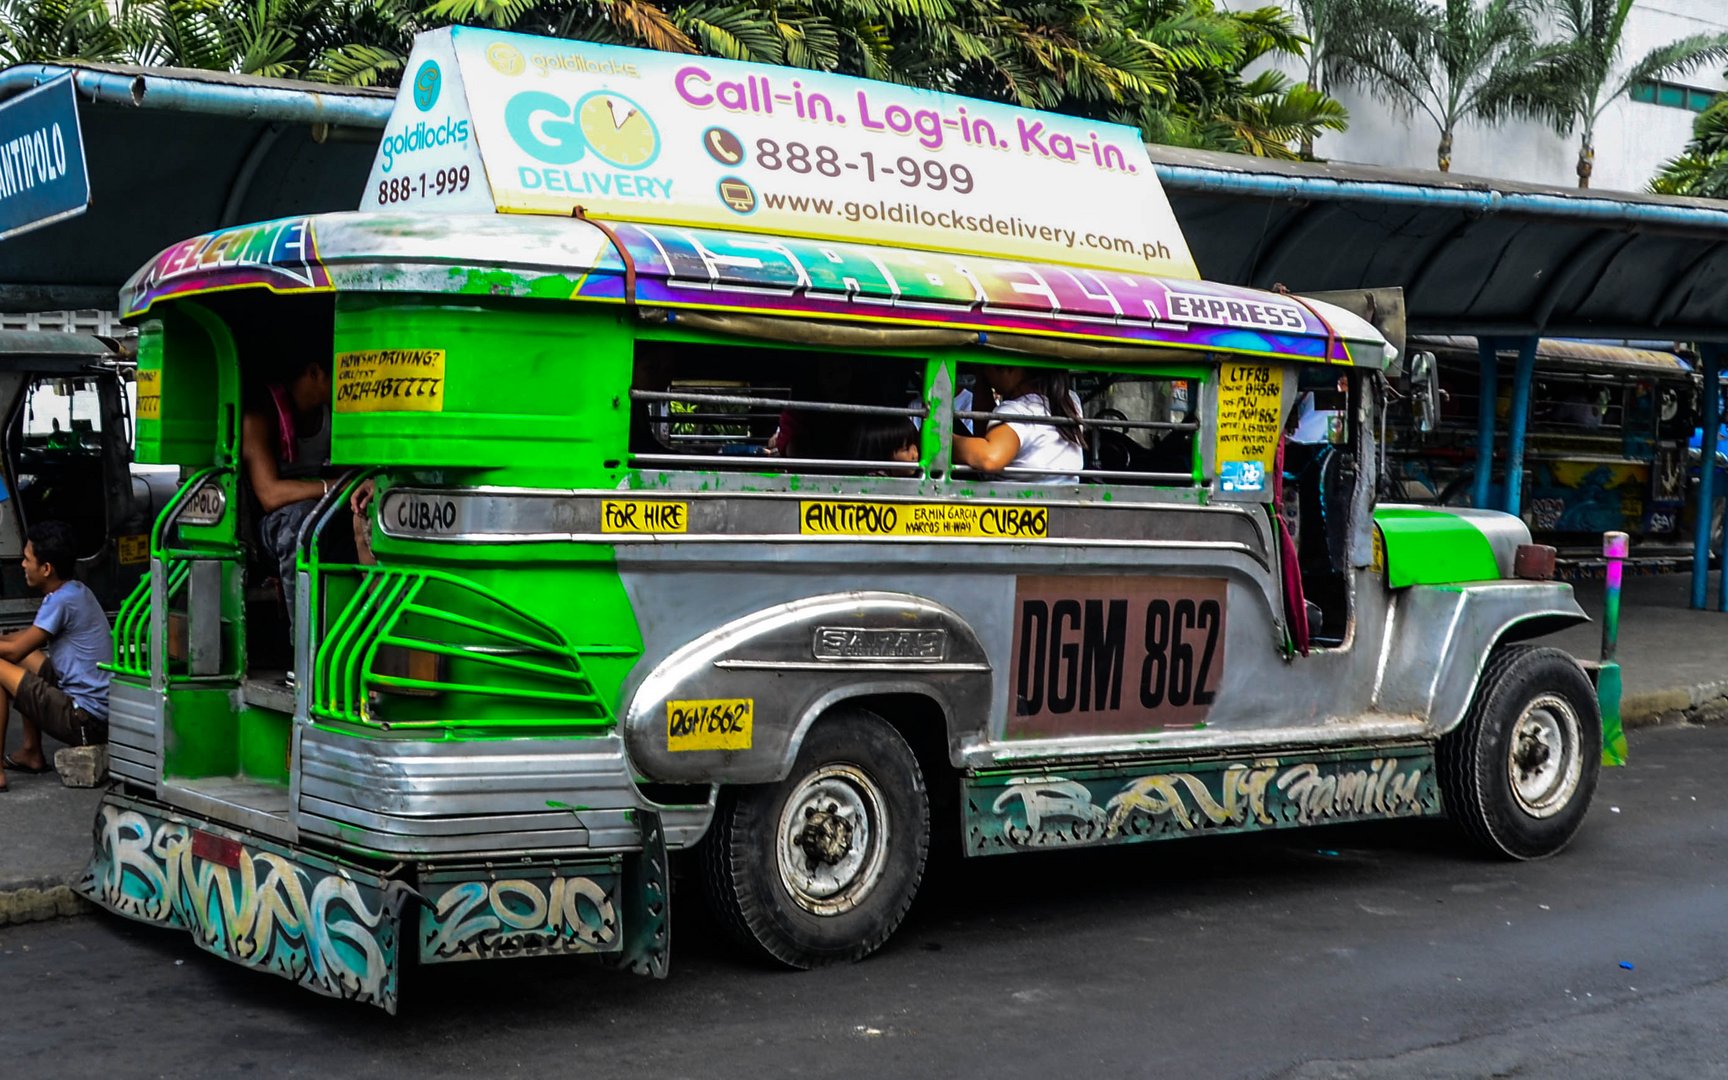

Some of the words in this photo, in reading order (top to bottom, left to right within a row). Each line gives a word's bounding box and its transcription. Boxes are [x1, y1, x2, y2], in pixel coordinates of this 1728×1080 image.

[530, 53, 642, 79] goldilocks
[505, 90, 662, 171] GO
[675, 66, 847, 124] Call-in.
[857, 90, 1008, 149] Log-in.
[1016, 117, 1137, 173] Ka-in.
[382, 115, 469, 173] goldilocks
[518, 166, 673, 199] DELIVERY
[756, 137, 974, 194] 888-1-999
[378, 165, 470, 205] 888-1-999
[764, 192, 1172, 260] www.goldilocksdelivery.com.ph
[130, 215, 316, 308] WELCOME
[1171, 295, 1303, 329] EXPRESS
[378, 351, 440, 367] DRIVING?
[1231, 367, 1270, 383] LTFRB
[398, 501, 456, 530] CUBAO
[605, 502, 639, 529] FOR
[644, 504, 684, 529] HIRE
[805, 503, 898, 533] ANTIPOLO
[905, 521, 940, 533] MARCOS
[979, 508, 1047, 536] CUBAO
[1016, 598, 1129, 717] DGM
[1139, 598, 1222, 710] 862
[426, 876, 617, 950] 2010
